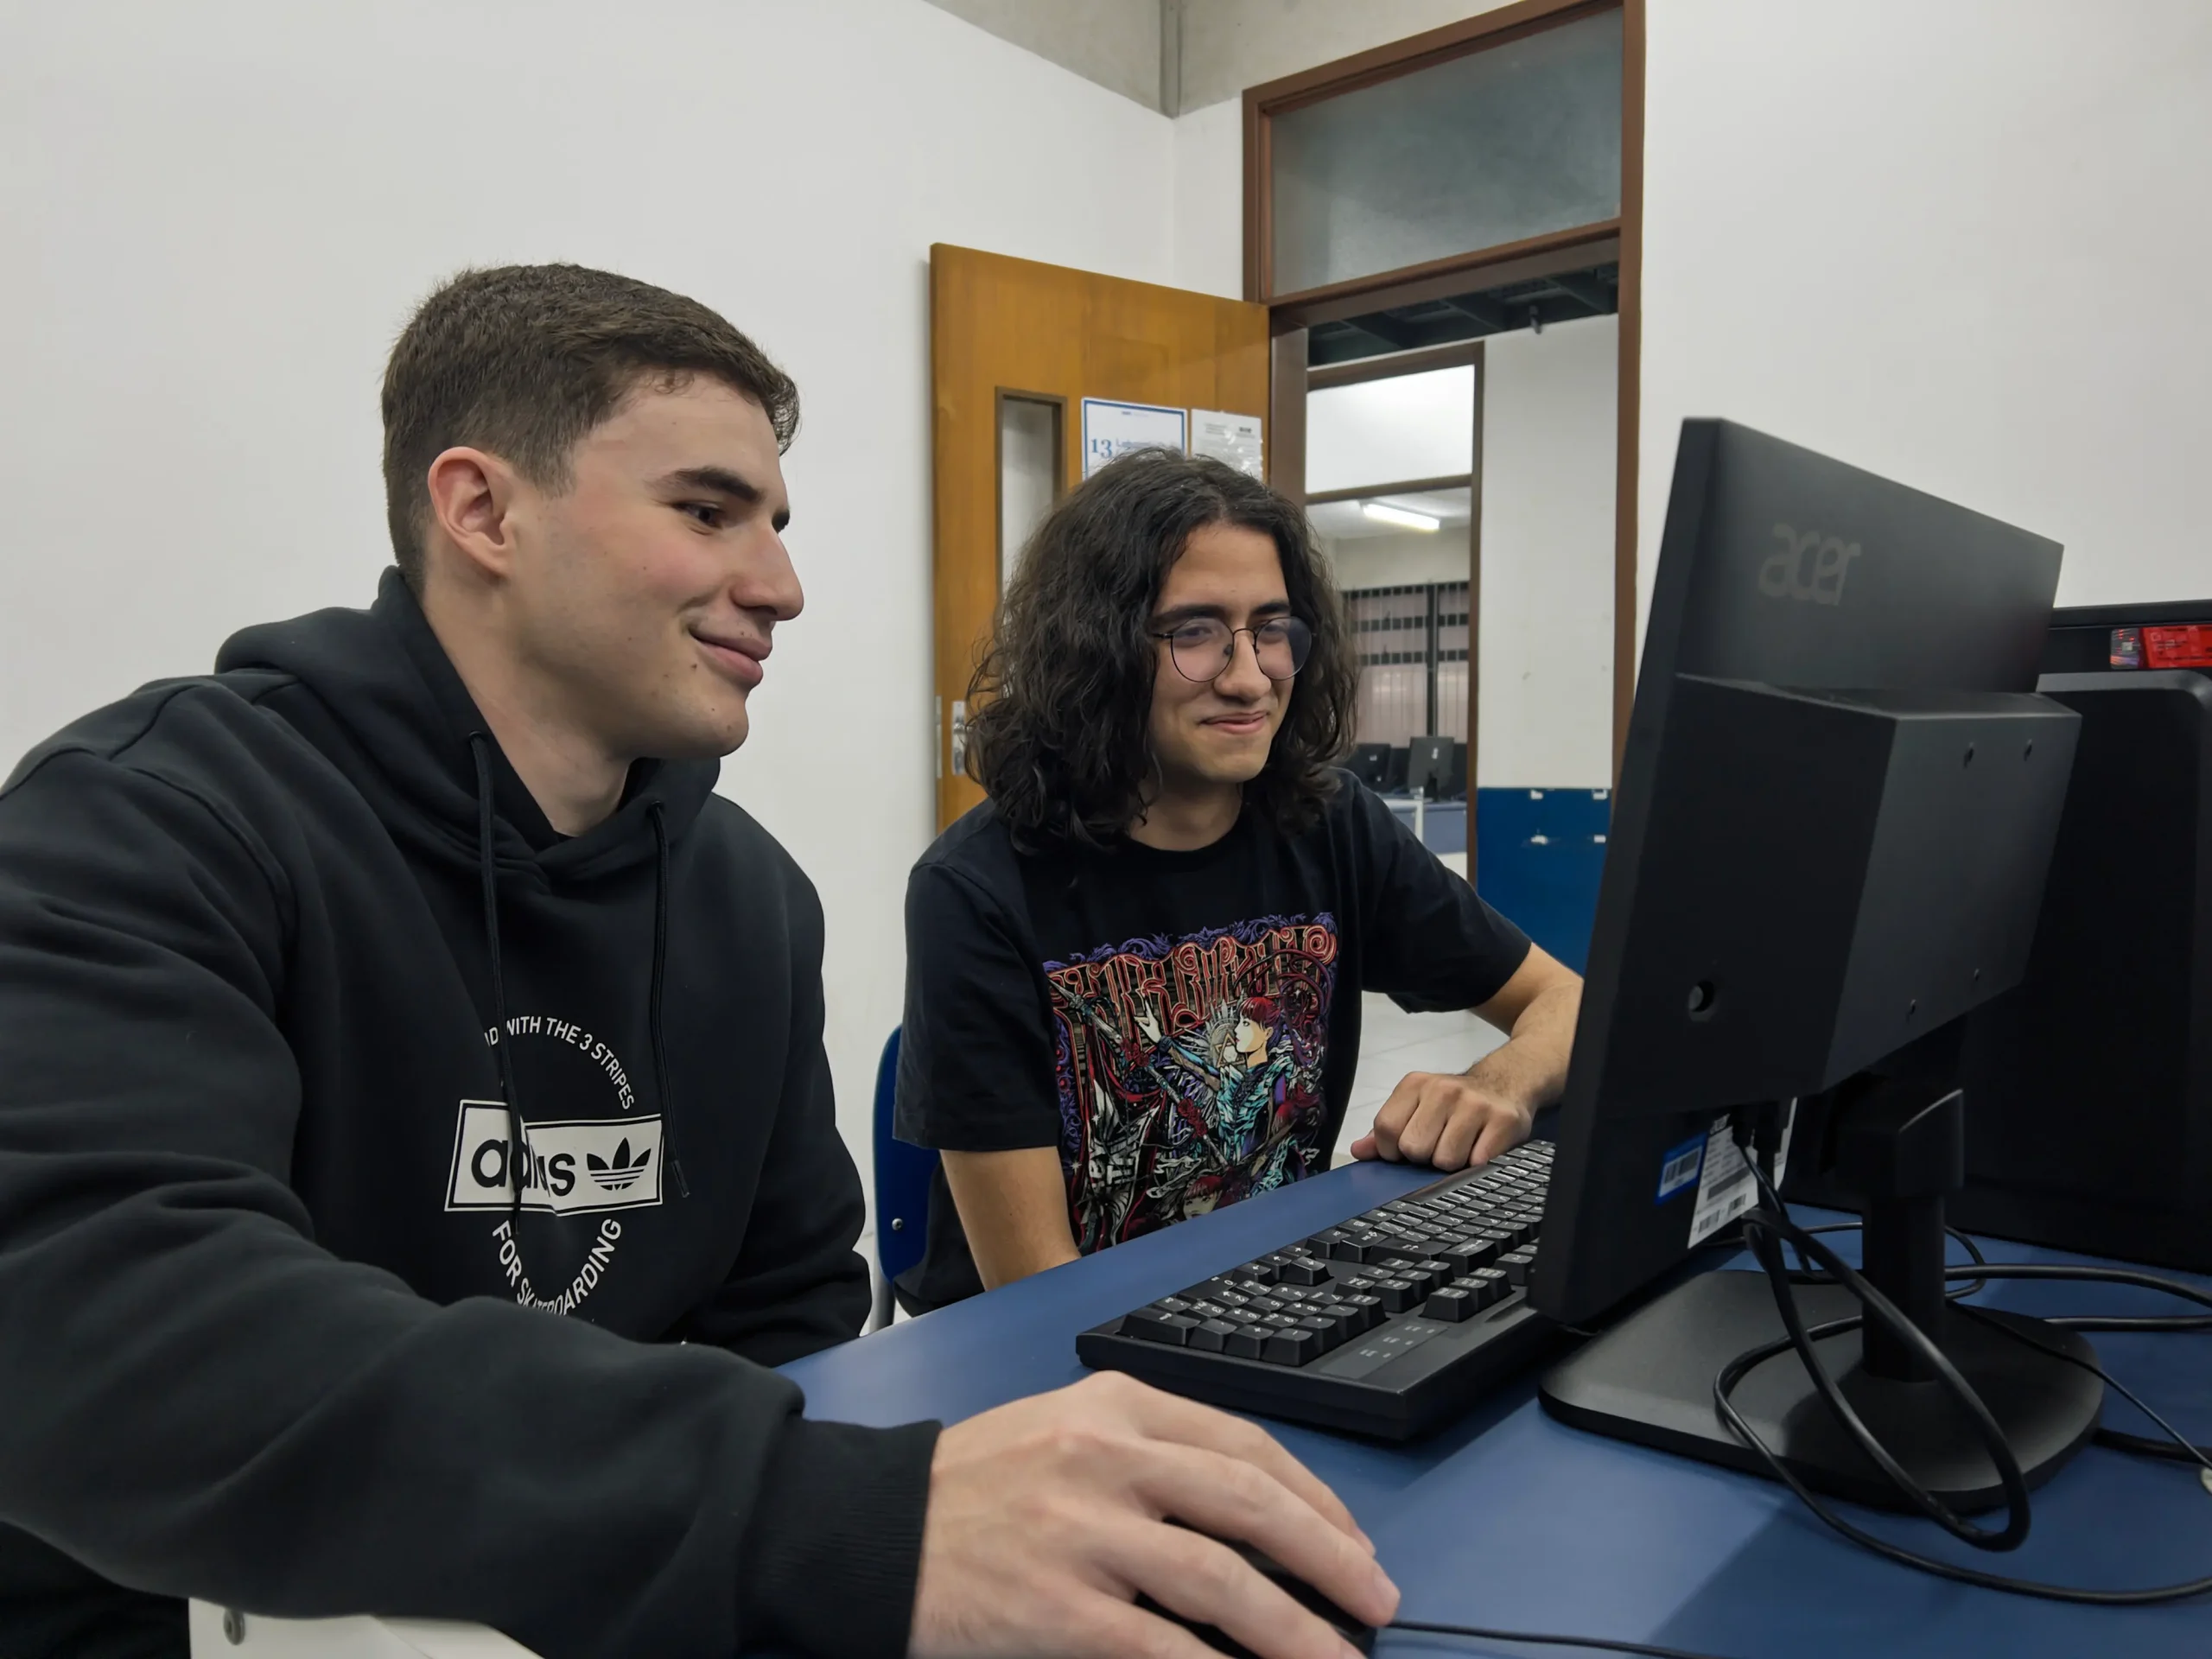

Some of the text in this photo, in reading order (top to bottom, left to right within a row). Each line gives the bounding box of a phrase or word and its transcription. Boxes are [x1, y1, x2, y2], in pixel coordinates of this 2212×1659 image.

[1090, 438, 1113, 459] 13
[1758, 522, 1861, 605] acer
[506, 1015, 542, 1036] WITH
[546, 1017, 582, 1045] THE
[579, 1033, 593, 1051] 3
[591, 1043, 634, 1109] STRIPES
[492, 1220, 522, 1287] FOR
